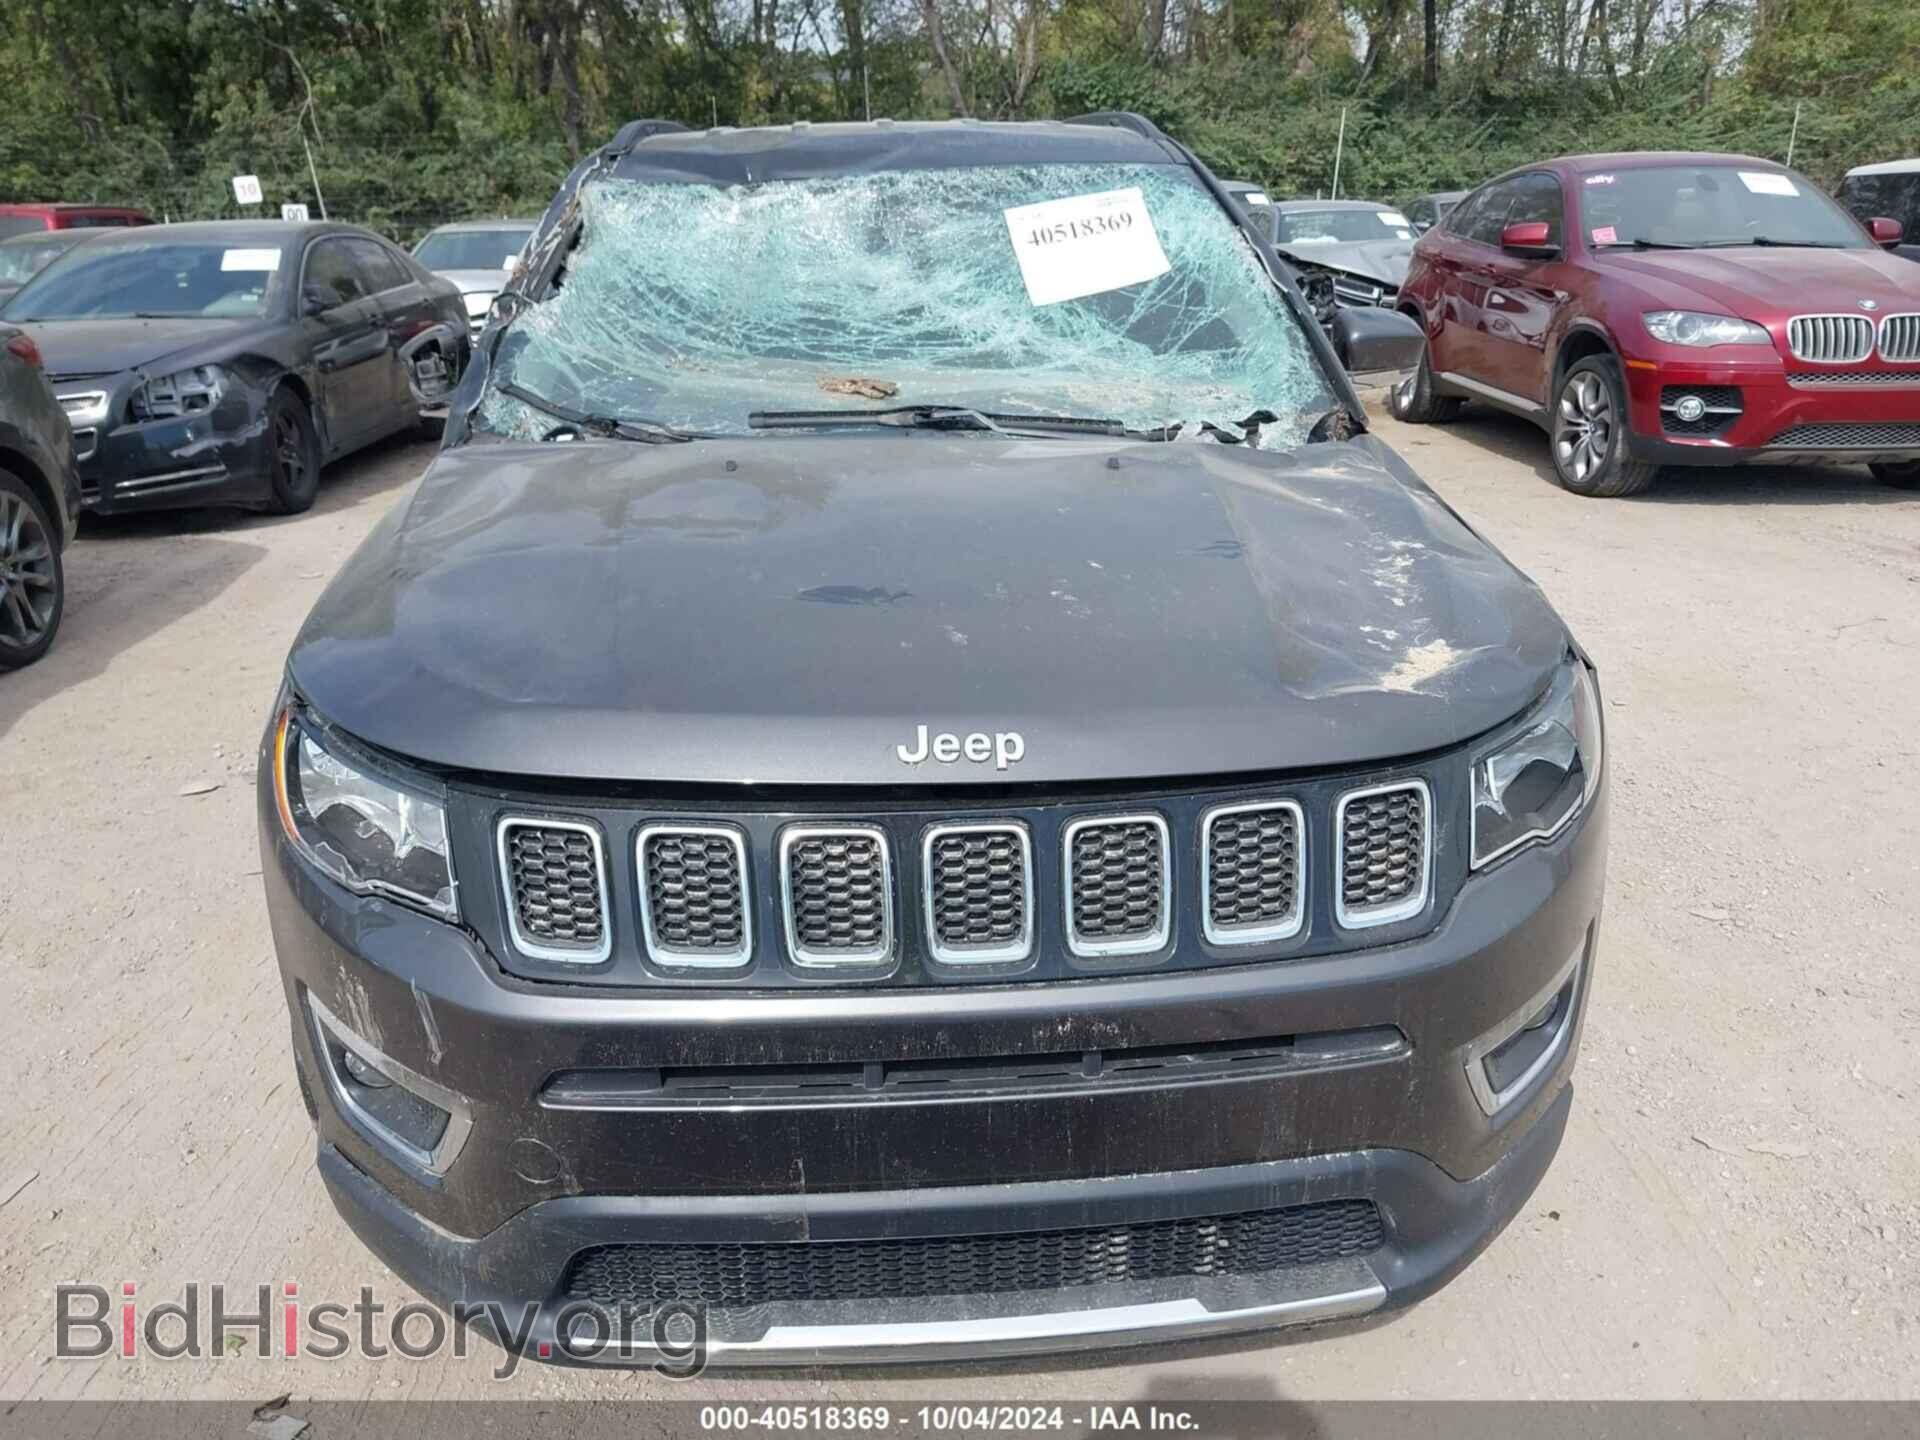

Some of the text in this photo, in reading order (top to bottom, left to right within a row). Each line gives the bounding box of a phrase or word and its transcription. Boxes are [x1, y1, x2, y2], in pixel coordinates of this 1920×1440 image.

[239, 183, 257, 197] 10
[1028, 211, 1133, 246] 40518369
[897, 725, 1025, 769] Jeep
